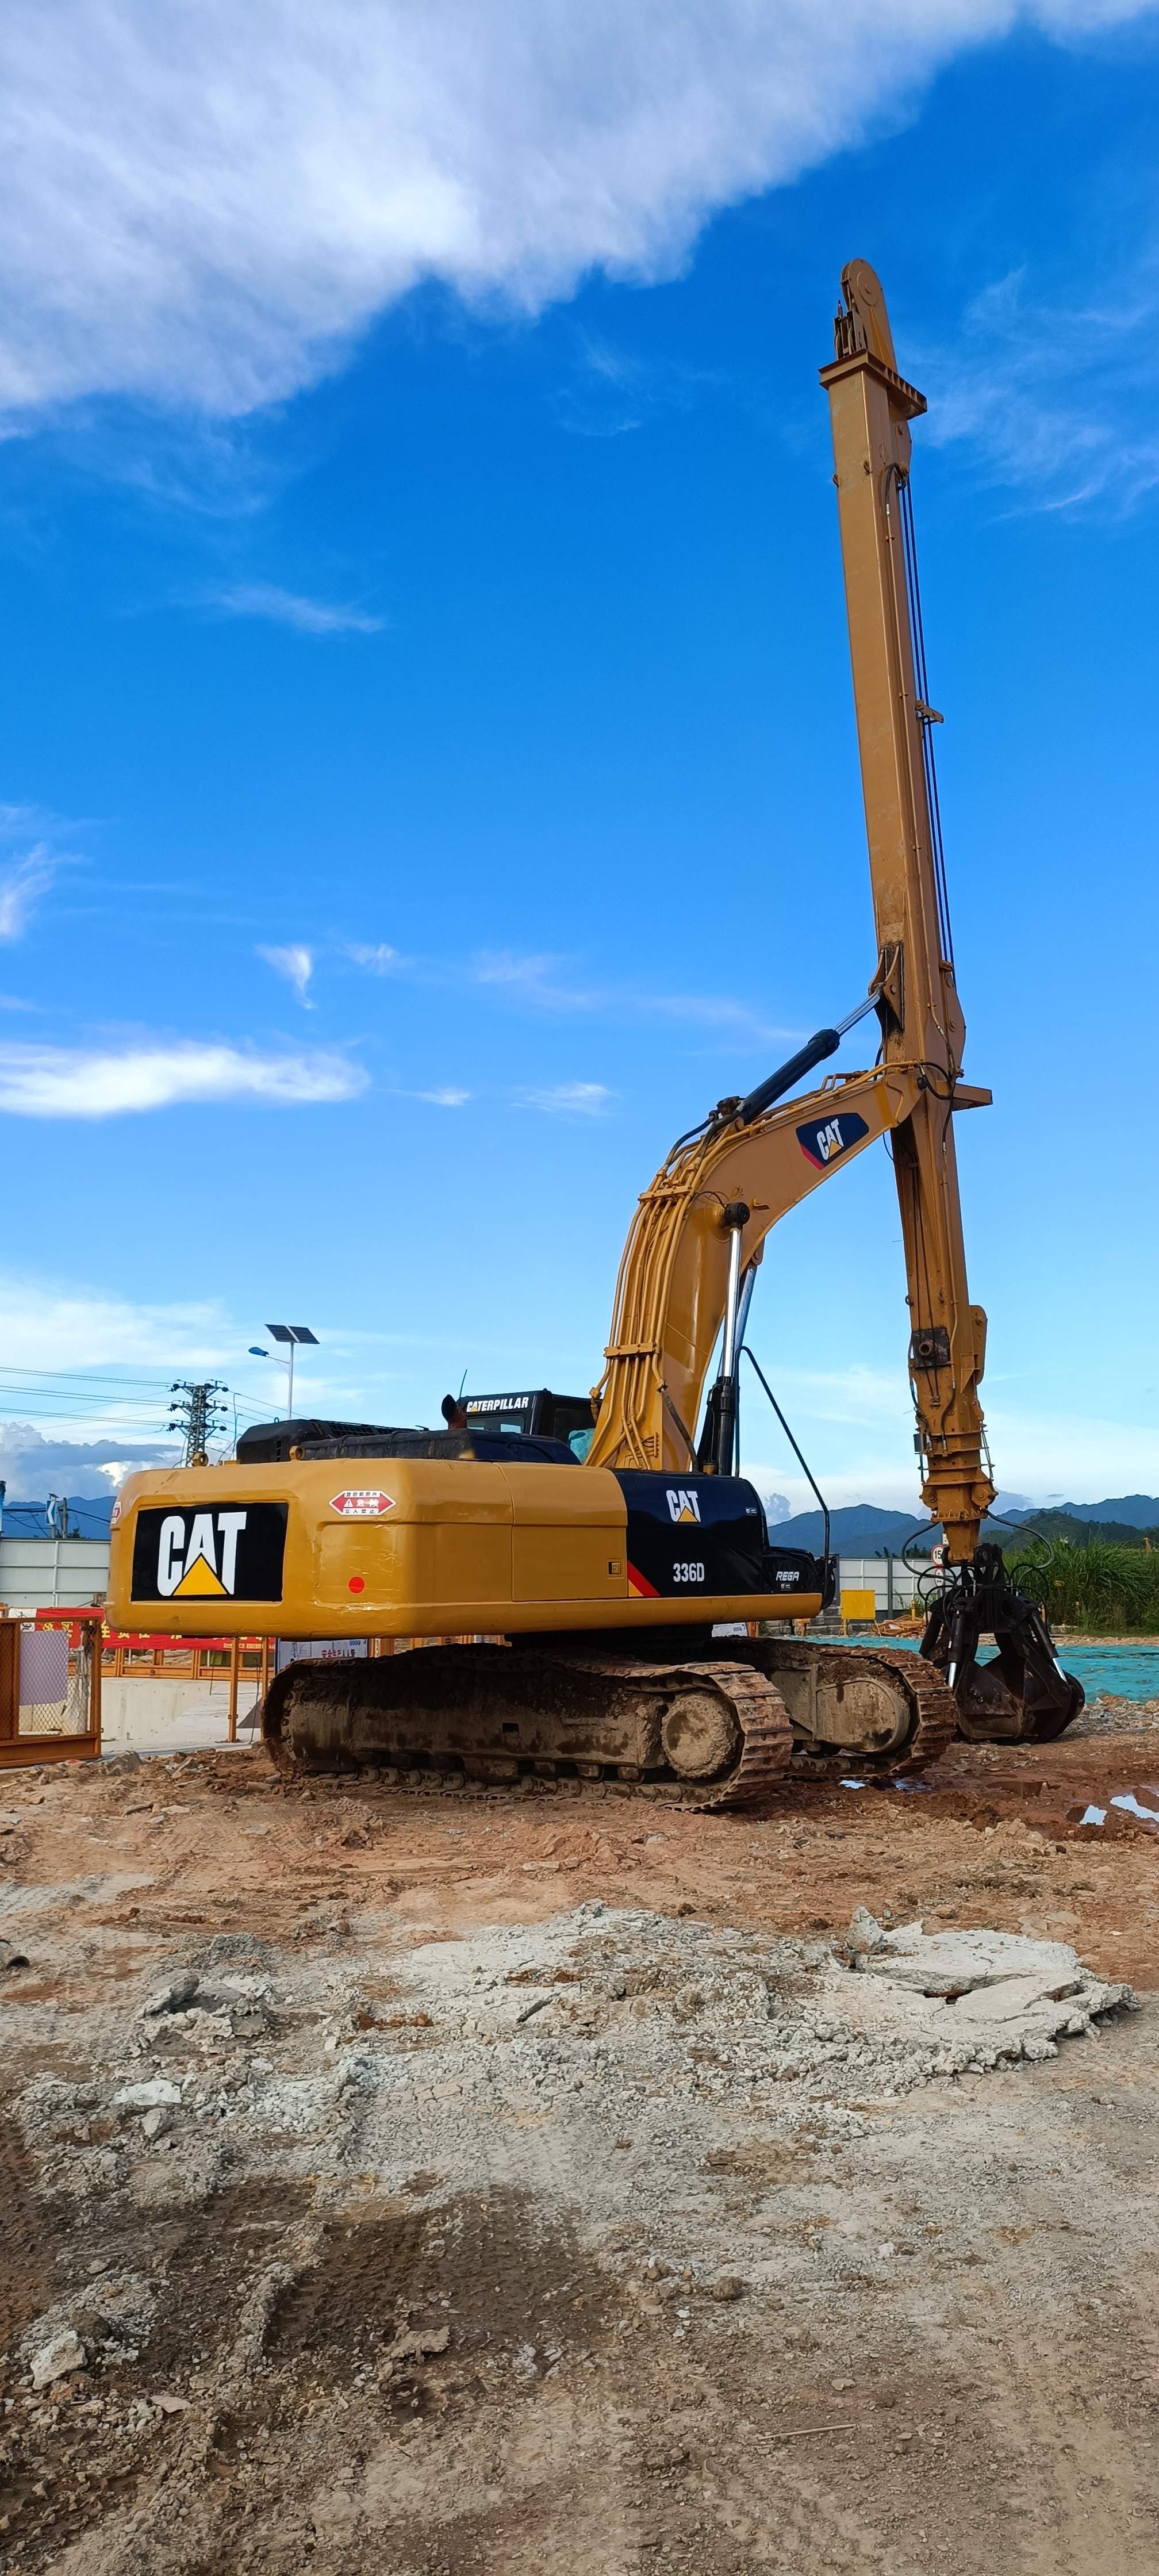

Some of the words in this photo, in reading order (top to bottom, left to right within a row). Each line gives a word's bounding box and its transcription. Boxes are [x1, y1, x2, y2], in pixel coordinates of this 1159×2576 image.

[816, 1118, 844, 1160] CAT
[466, 1397, 529, 1412] CATERPILLAR
[666, 1490, 701, 1523] CAT
[157, 1512, 247, 1596] CAT
[673, 1563, 705, 1582] 336D
[776, 1571, 800, 1581] REGA
